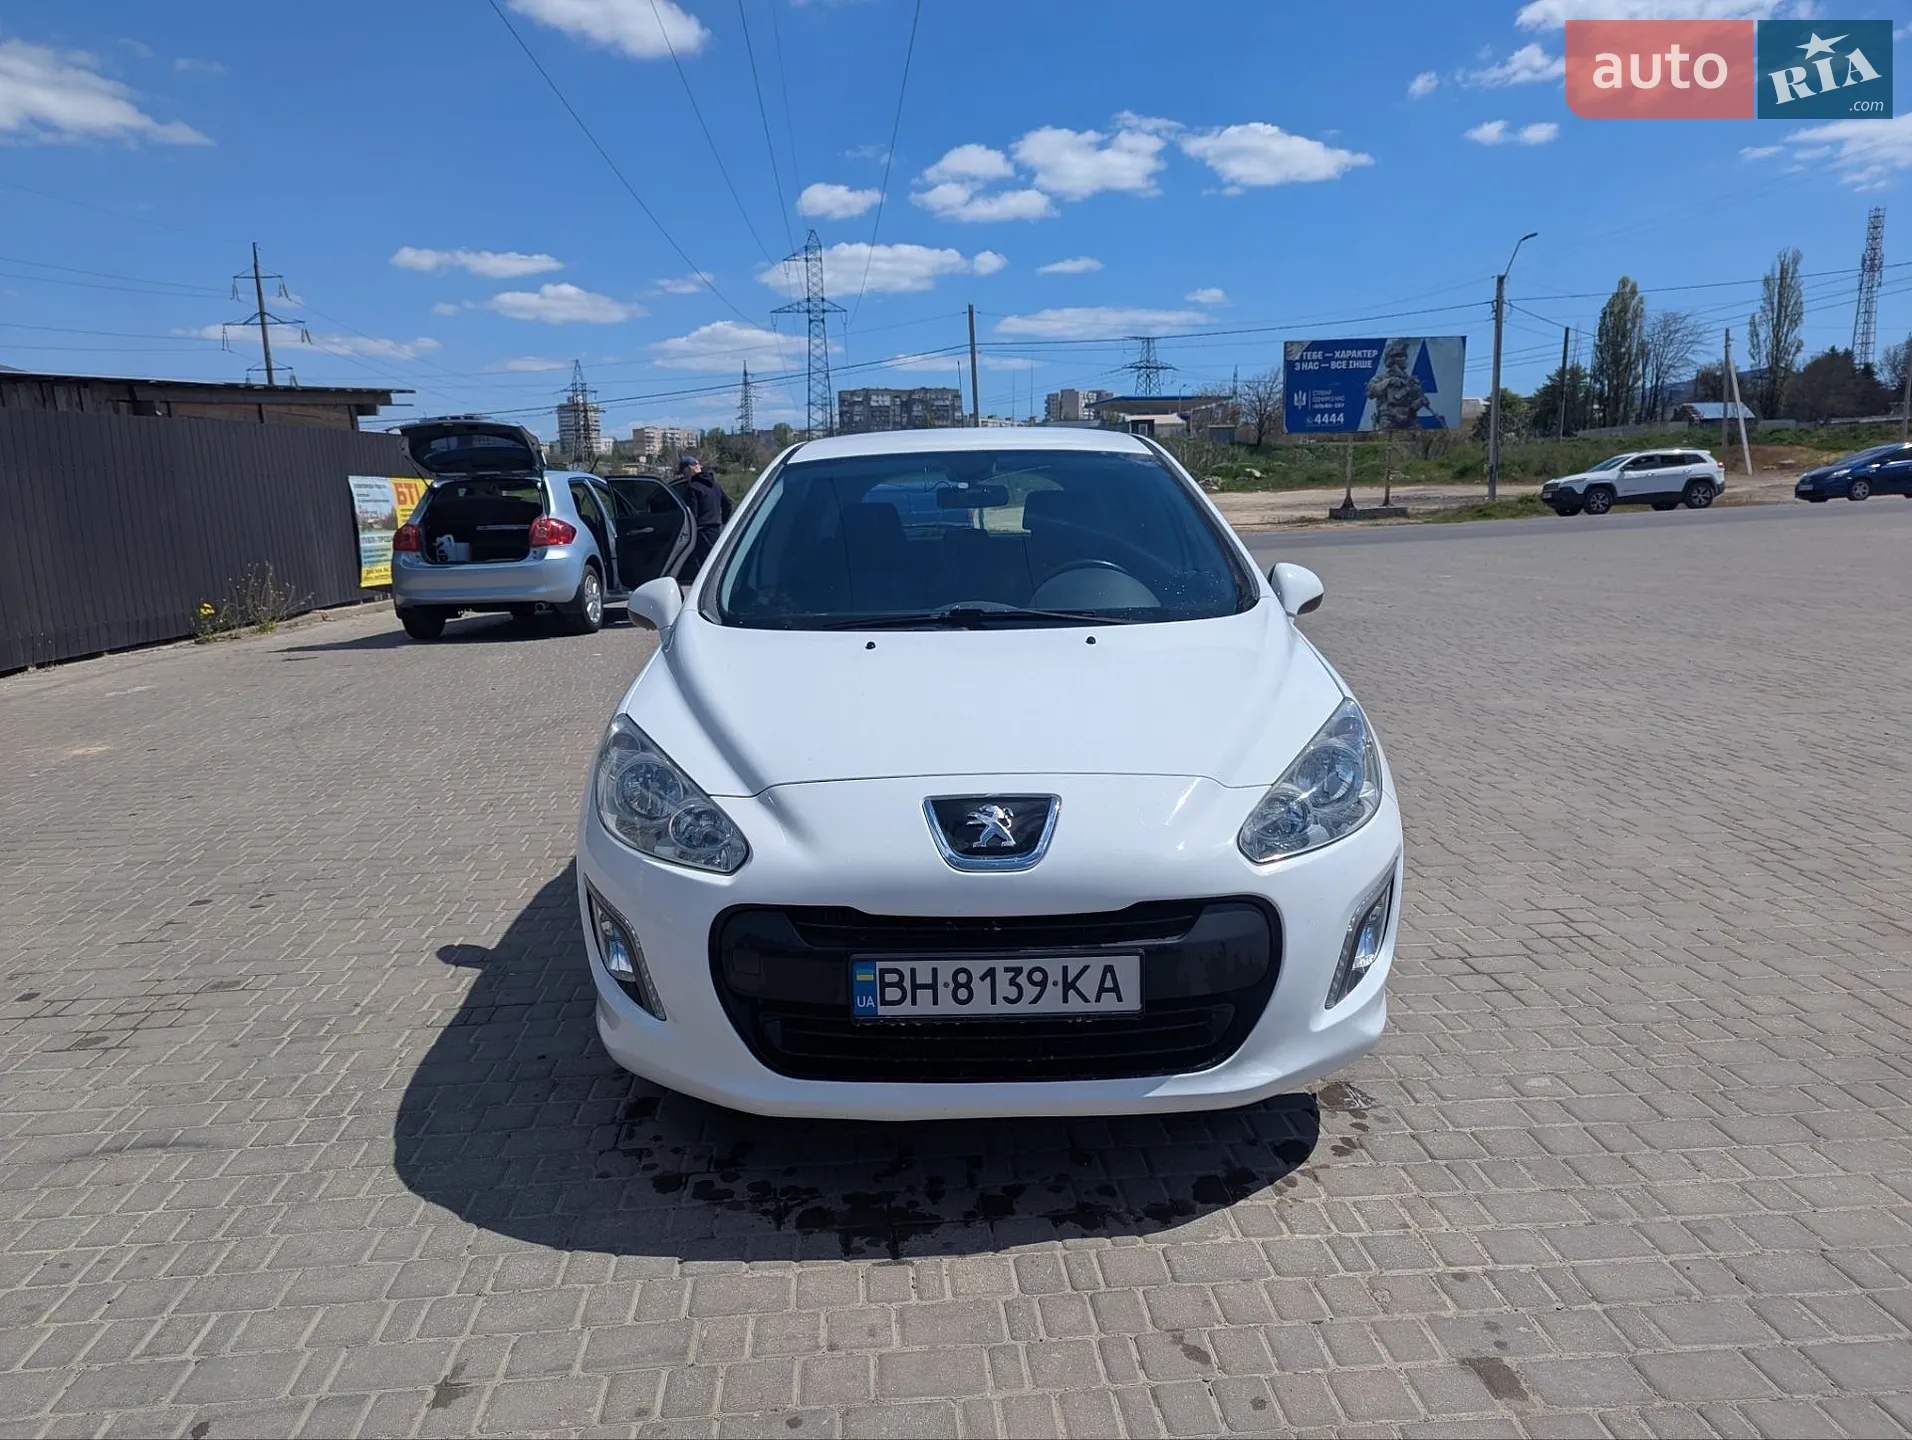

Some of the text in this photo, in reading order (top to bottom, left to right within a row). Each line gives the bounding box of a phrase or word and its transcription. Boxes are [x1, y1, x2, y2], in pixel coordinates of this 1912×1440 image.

[1302, 351, 1323, 360] ТЕБЕ
[1334, 349, 1379, 359] ХАРАКТЕР
[1301, 361, 1320, 371] НАС
[1330, 360, 1348, 369] ВСЕ
[1348, 360, 1373, 369] ІНШЕ
[1314, 411, 1345, 424] 4444
[951, 966, 1049, 1006] 8139
[856, 996, 876, 1008] UA
